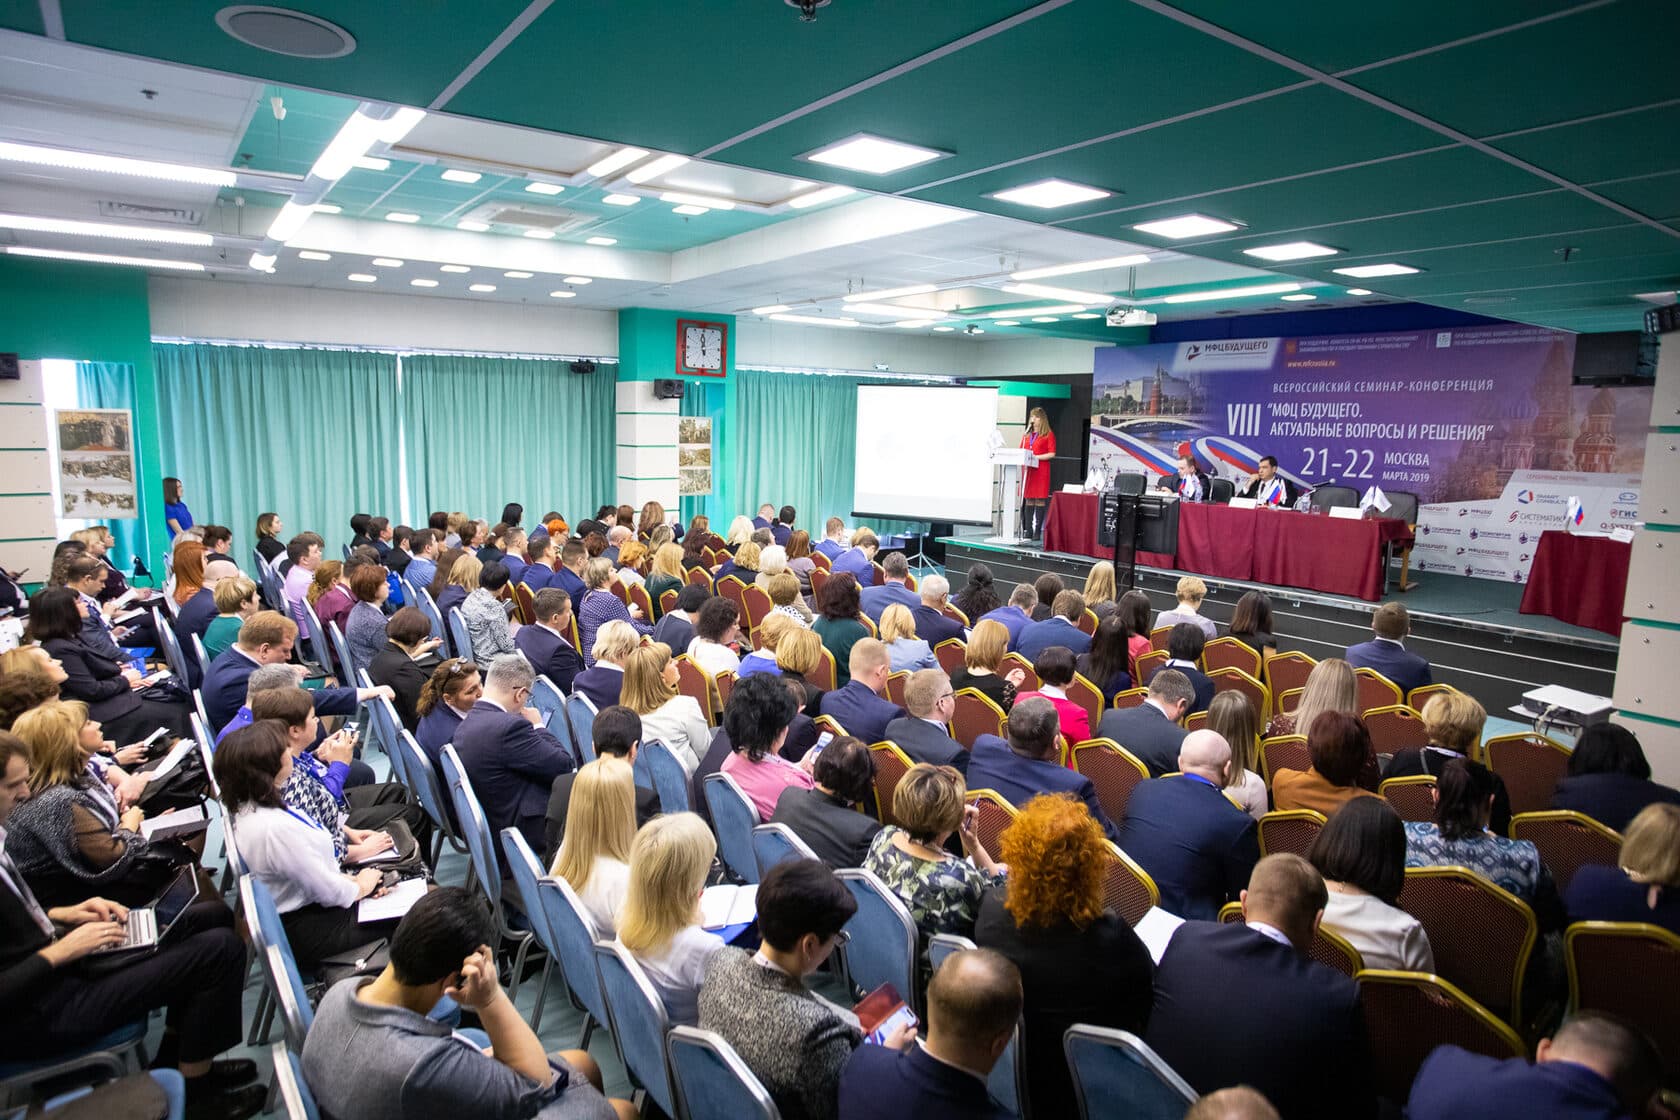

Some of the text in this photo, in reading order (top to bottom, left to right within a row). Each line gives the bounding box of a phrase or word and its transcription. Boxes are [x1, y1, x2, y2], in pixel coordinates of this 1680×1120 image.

[1204, 340, 1269, 352] МФЦБУДУЩЕГО
[1272, 379, 1494, 393] ВСЕРОССИЙСКИЙ СЕМИНАР-КОНФЕРЕНЦИЯ
[1300, 402, 1363, 419] БУДУЩЕГО.
[1227, 403, 1262, 437] VIII
[1269, 421, 1343, 438] АКТУАЛЬНЫЕ
[1345, 422, 1404, 440] ВОПРОСЫ
[1406, 424, 1418, 440] И
[1299, 447, 1375, 479] 21-22
[1383, 451, 1430, 466] МОСКВА
[1382, 471, 1430, 483] МАРТА 2019
[1520, 512, 1566, 522] СИСТЕМАТИК
